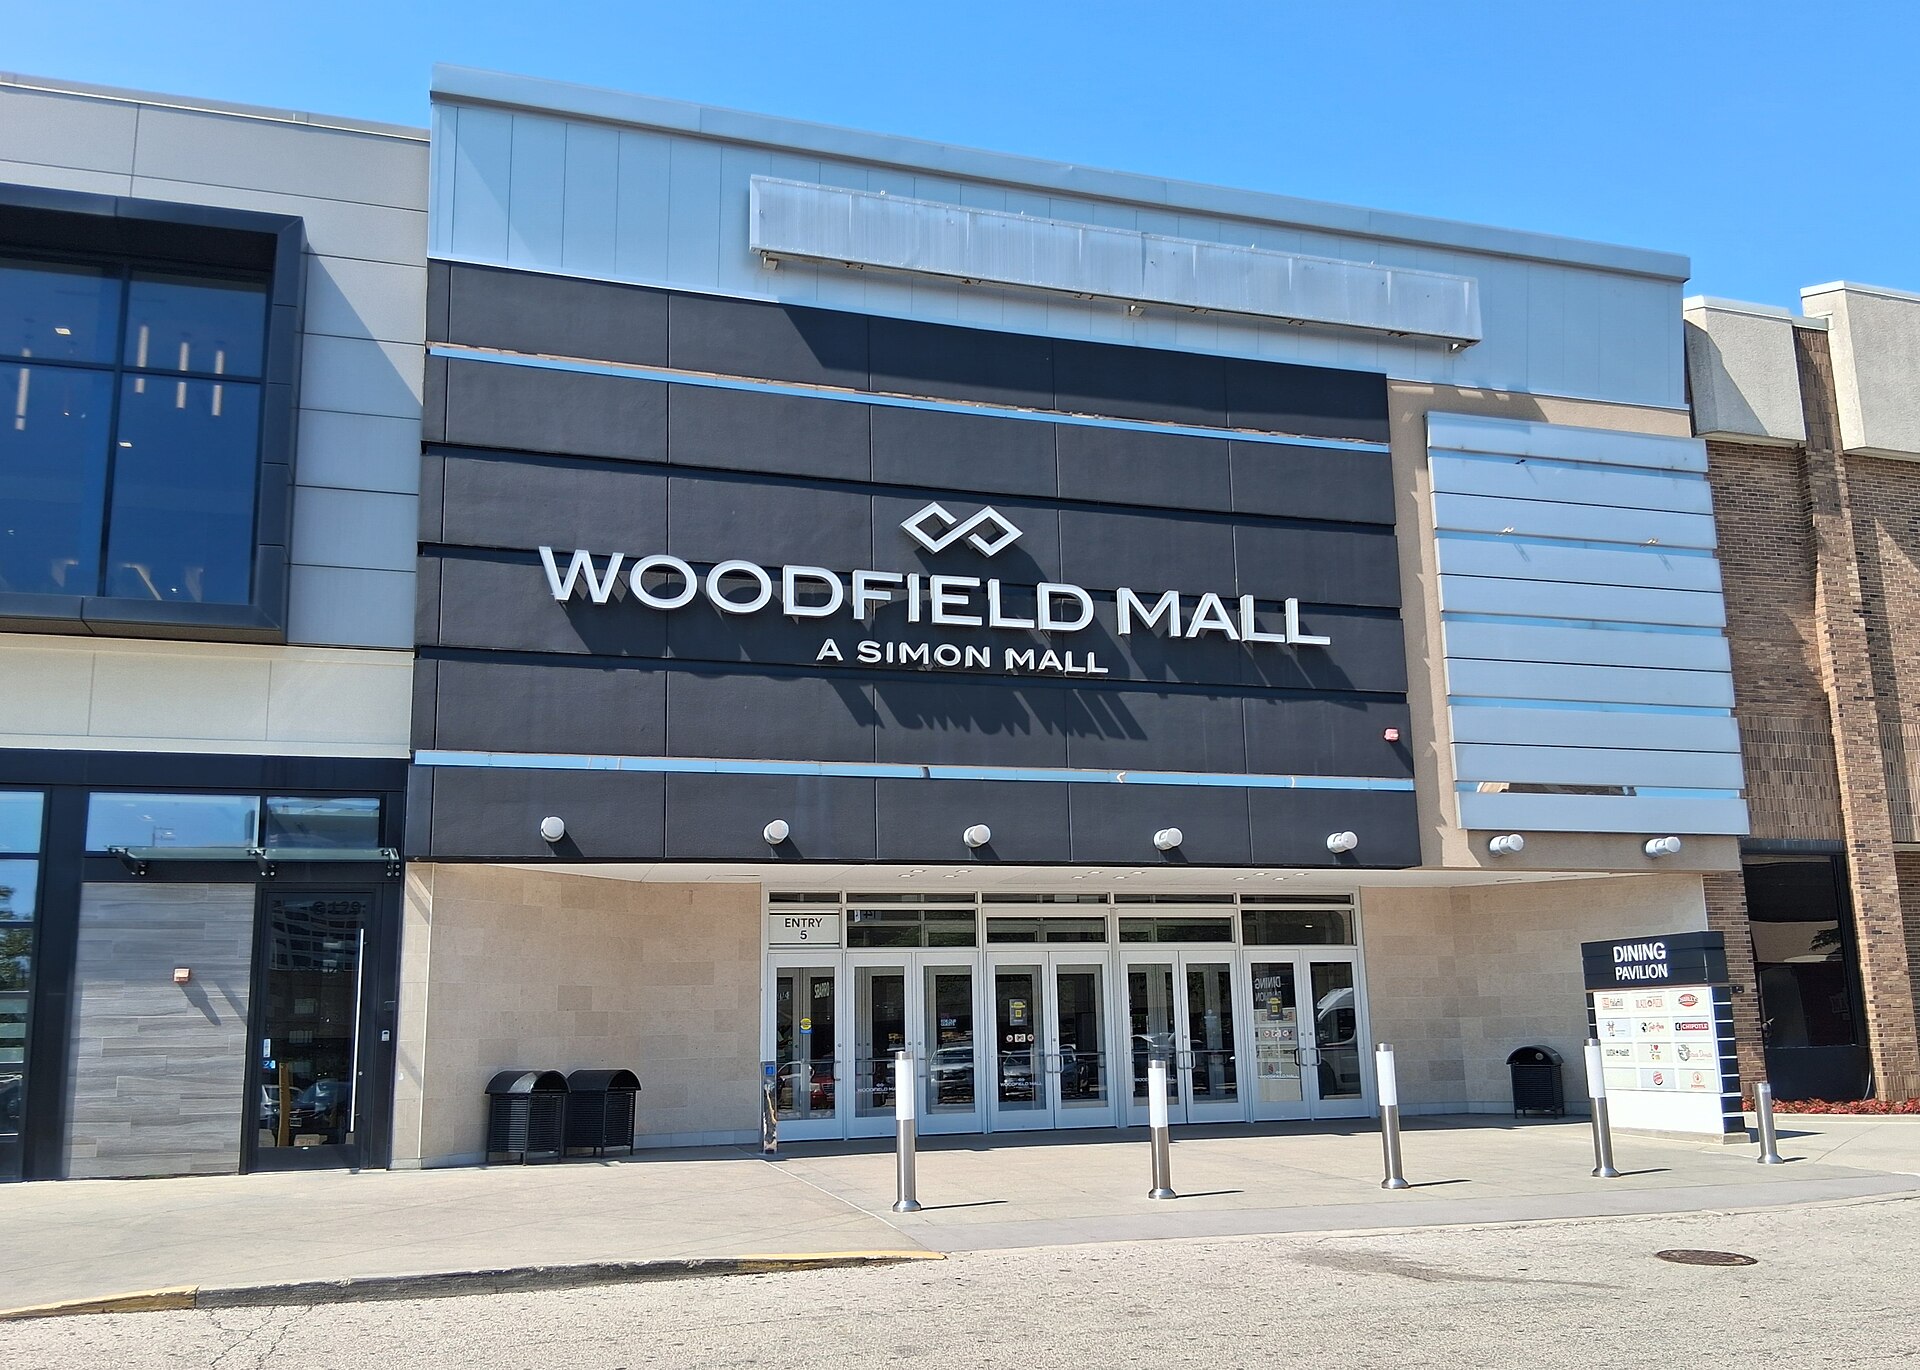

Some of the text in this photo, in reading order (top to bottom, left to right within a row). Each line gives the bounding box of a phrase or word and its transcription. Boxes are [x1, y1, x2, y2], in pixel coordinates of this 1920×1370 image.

[538, 546, 1331, 646] WOODFIELD MALL
[816, 638, 1109, 674] A SIMON MALL
[785, 918, 823, 928] ENTRY
[800, 930, 808, 940] 5
[1613, 942, 1667, 963] DINING
[1615, 963, 1669, 980] PAVILION
[1682, 1022, 1709, 1030] CHIPOTLE
